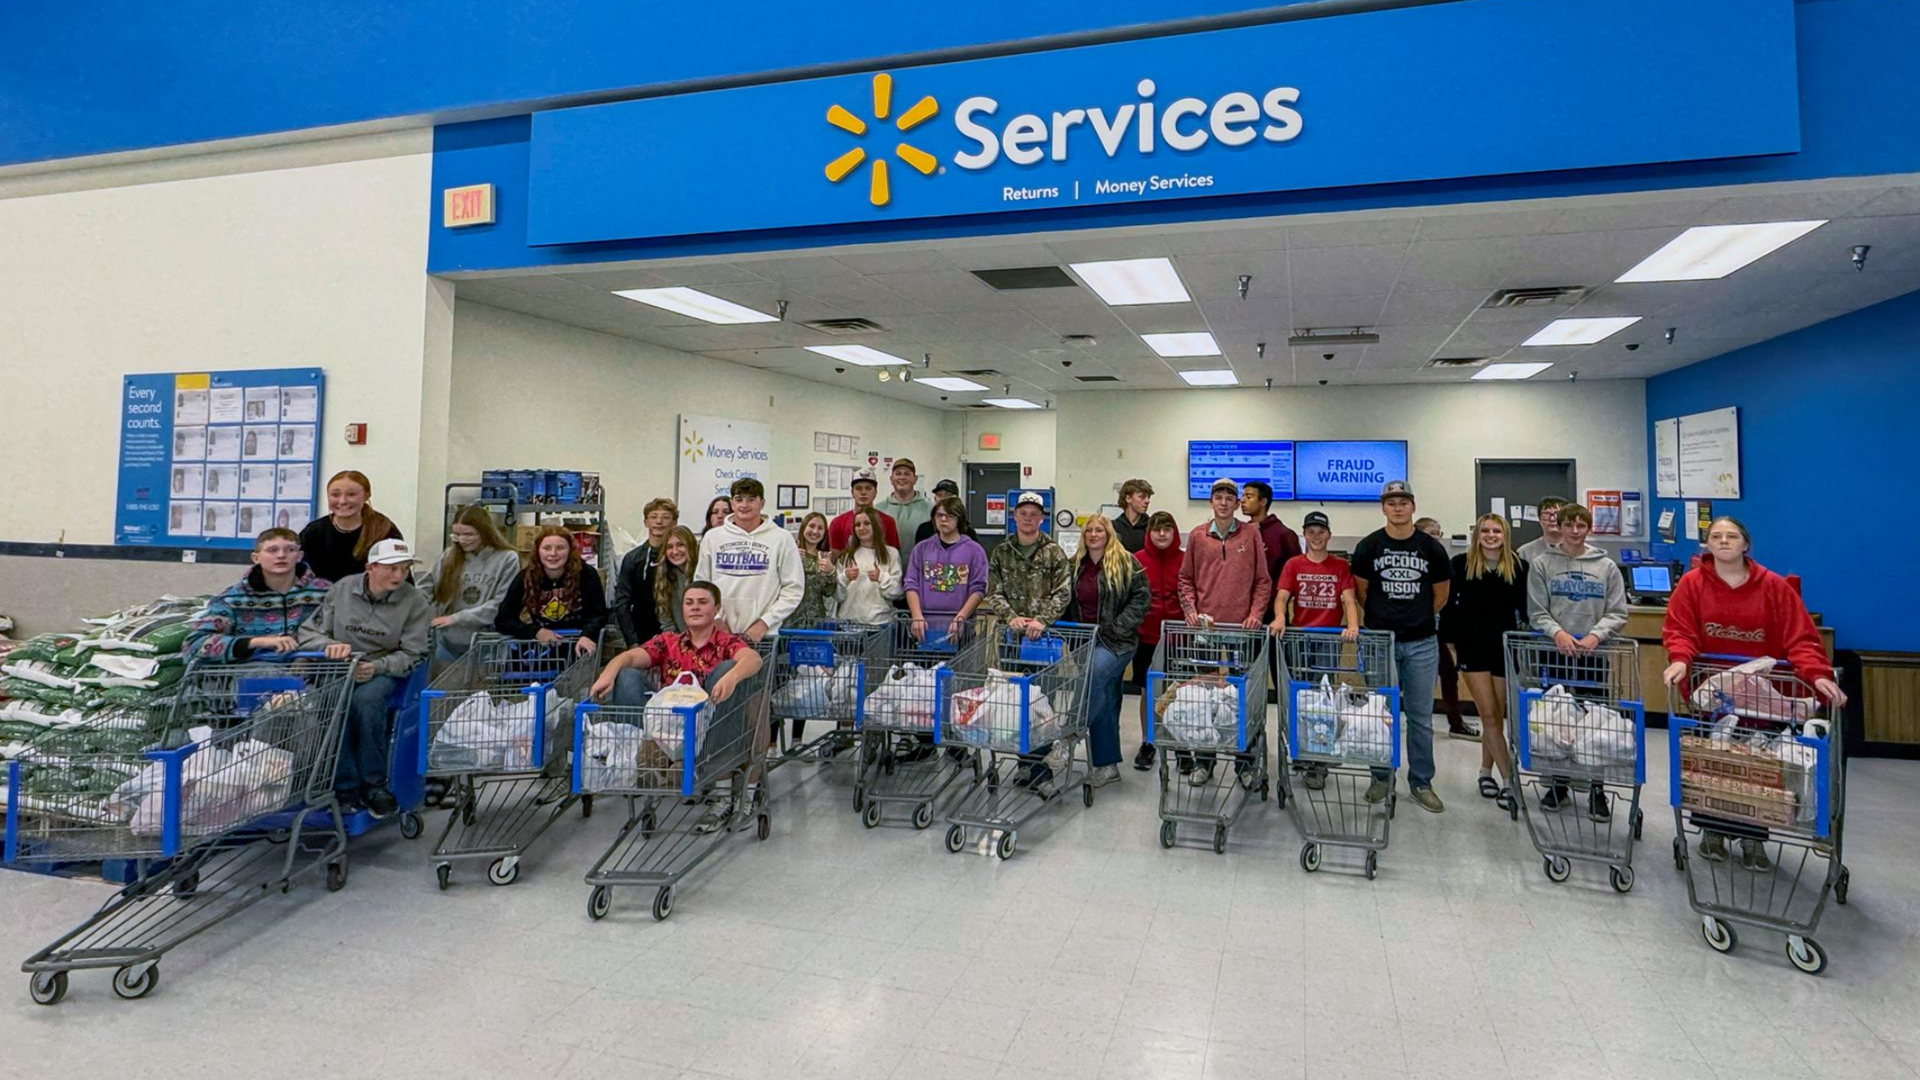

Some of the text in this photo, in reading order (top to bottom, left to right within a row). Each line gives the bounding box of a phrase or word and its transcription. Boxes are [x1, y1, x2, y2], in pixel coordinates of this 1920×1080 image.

[953, 78, 1304, 170] Services
[1003, 173, 1214, 201] Returns Money Services
[452, 190, 483, 220] EXIT
[129, 385, 156, 402] Every
[128, 400, 162, 414] second
[127, 418, 162, 429] counts.
[706, 444, 769, 462] Money Services
[1192, 443, 1211, 451] Money
[1327, 459, 1375, 471] FRAUD
[715, 468, 735, 479] Check
[1317, 471, 1385, 483] WARNING
[716, 552, 770, 565] FOOTBALL
[1389, 570, 1412, 579] XXL
[1381, 581, 1421, 594] BISON
[1551, 580, 1604, 594] PLAYOFFS
[345, 624, 386, 636] CINCH
